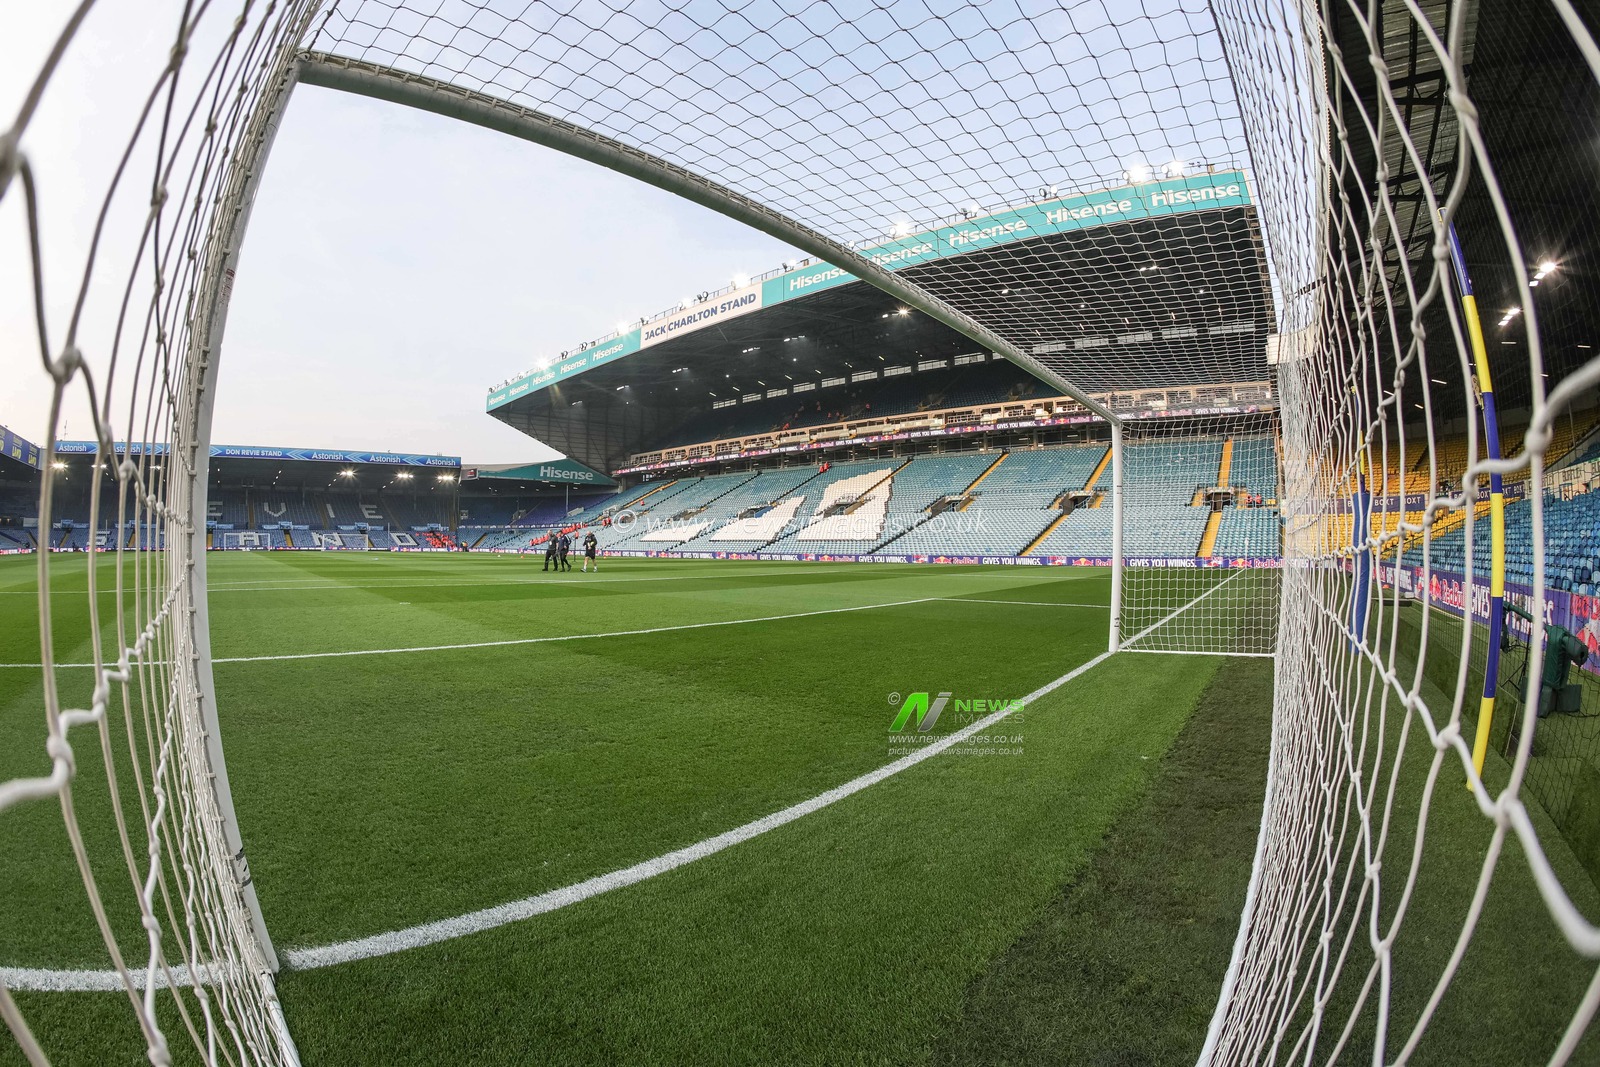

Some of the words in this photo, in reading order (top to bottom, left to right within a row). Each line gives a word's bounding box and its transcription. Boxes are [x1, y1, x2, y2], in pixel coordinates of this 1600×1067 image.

[1152, 183, 1240, 207] Hisense
[1046, 199, 1132, 224] Hisense
[950, 218, 1028, 247] Hisense
[644, 325, 666, 341] JACK
[668, 305, 718, 332] CHARLTON
[720, 293, 756, 314] STAND
[592, 343, 624, 361] Hisense
[560, 358, 586, 375] Hisense
[532, 371, 556, 386] Hisense
[508, 382, 528, 397] Hisense
[488, 393, 506, 406] Hisense
[58, 444, 86, 452] Astonish
[312, 452, 344, 460] Astonish
[370, 455, 400, 463] Astonish
[426, 458, 456, 466] Astonish
[540, 466, 594, 481] Hisense
[982, 557, 1000, 565] GIVES
[1001, 557, 1014, 565] YOU
[1130, 558, 1149, 567] GIVES
[1151, 558, 1166, 567] YOU
